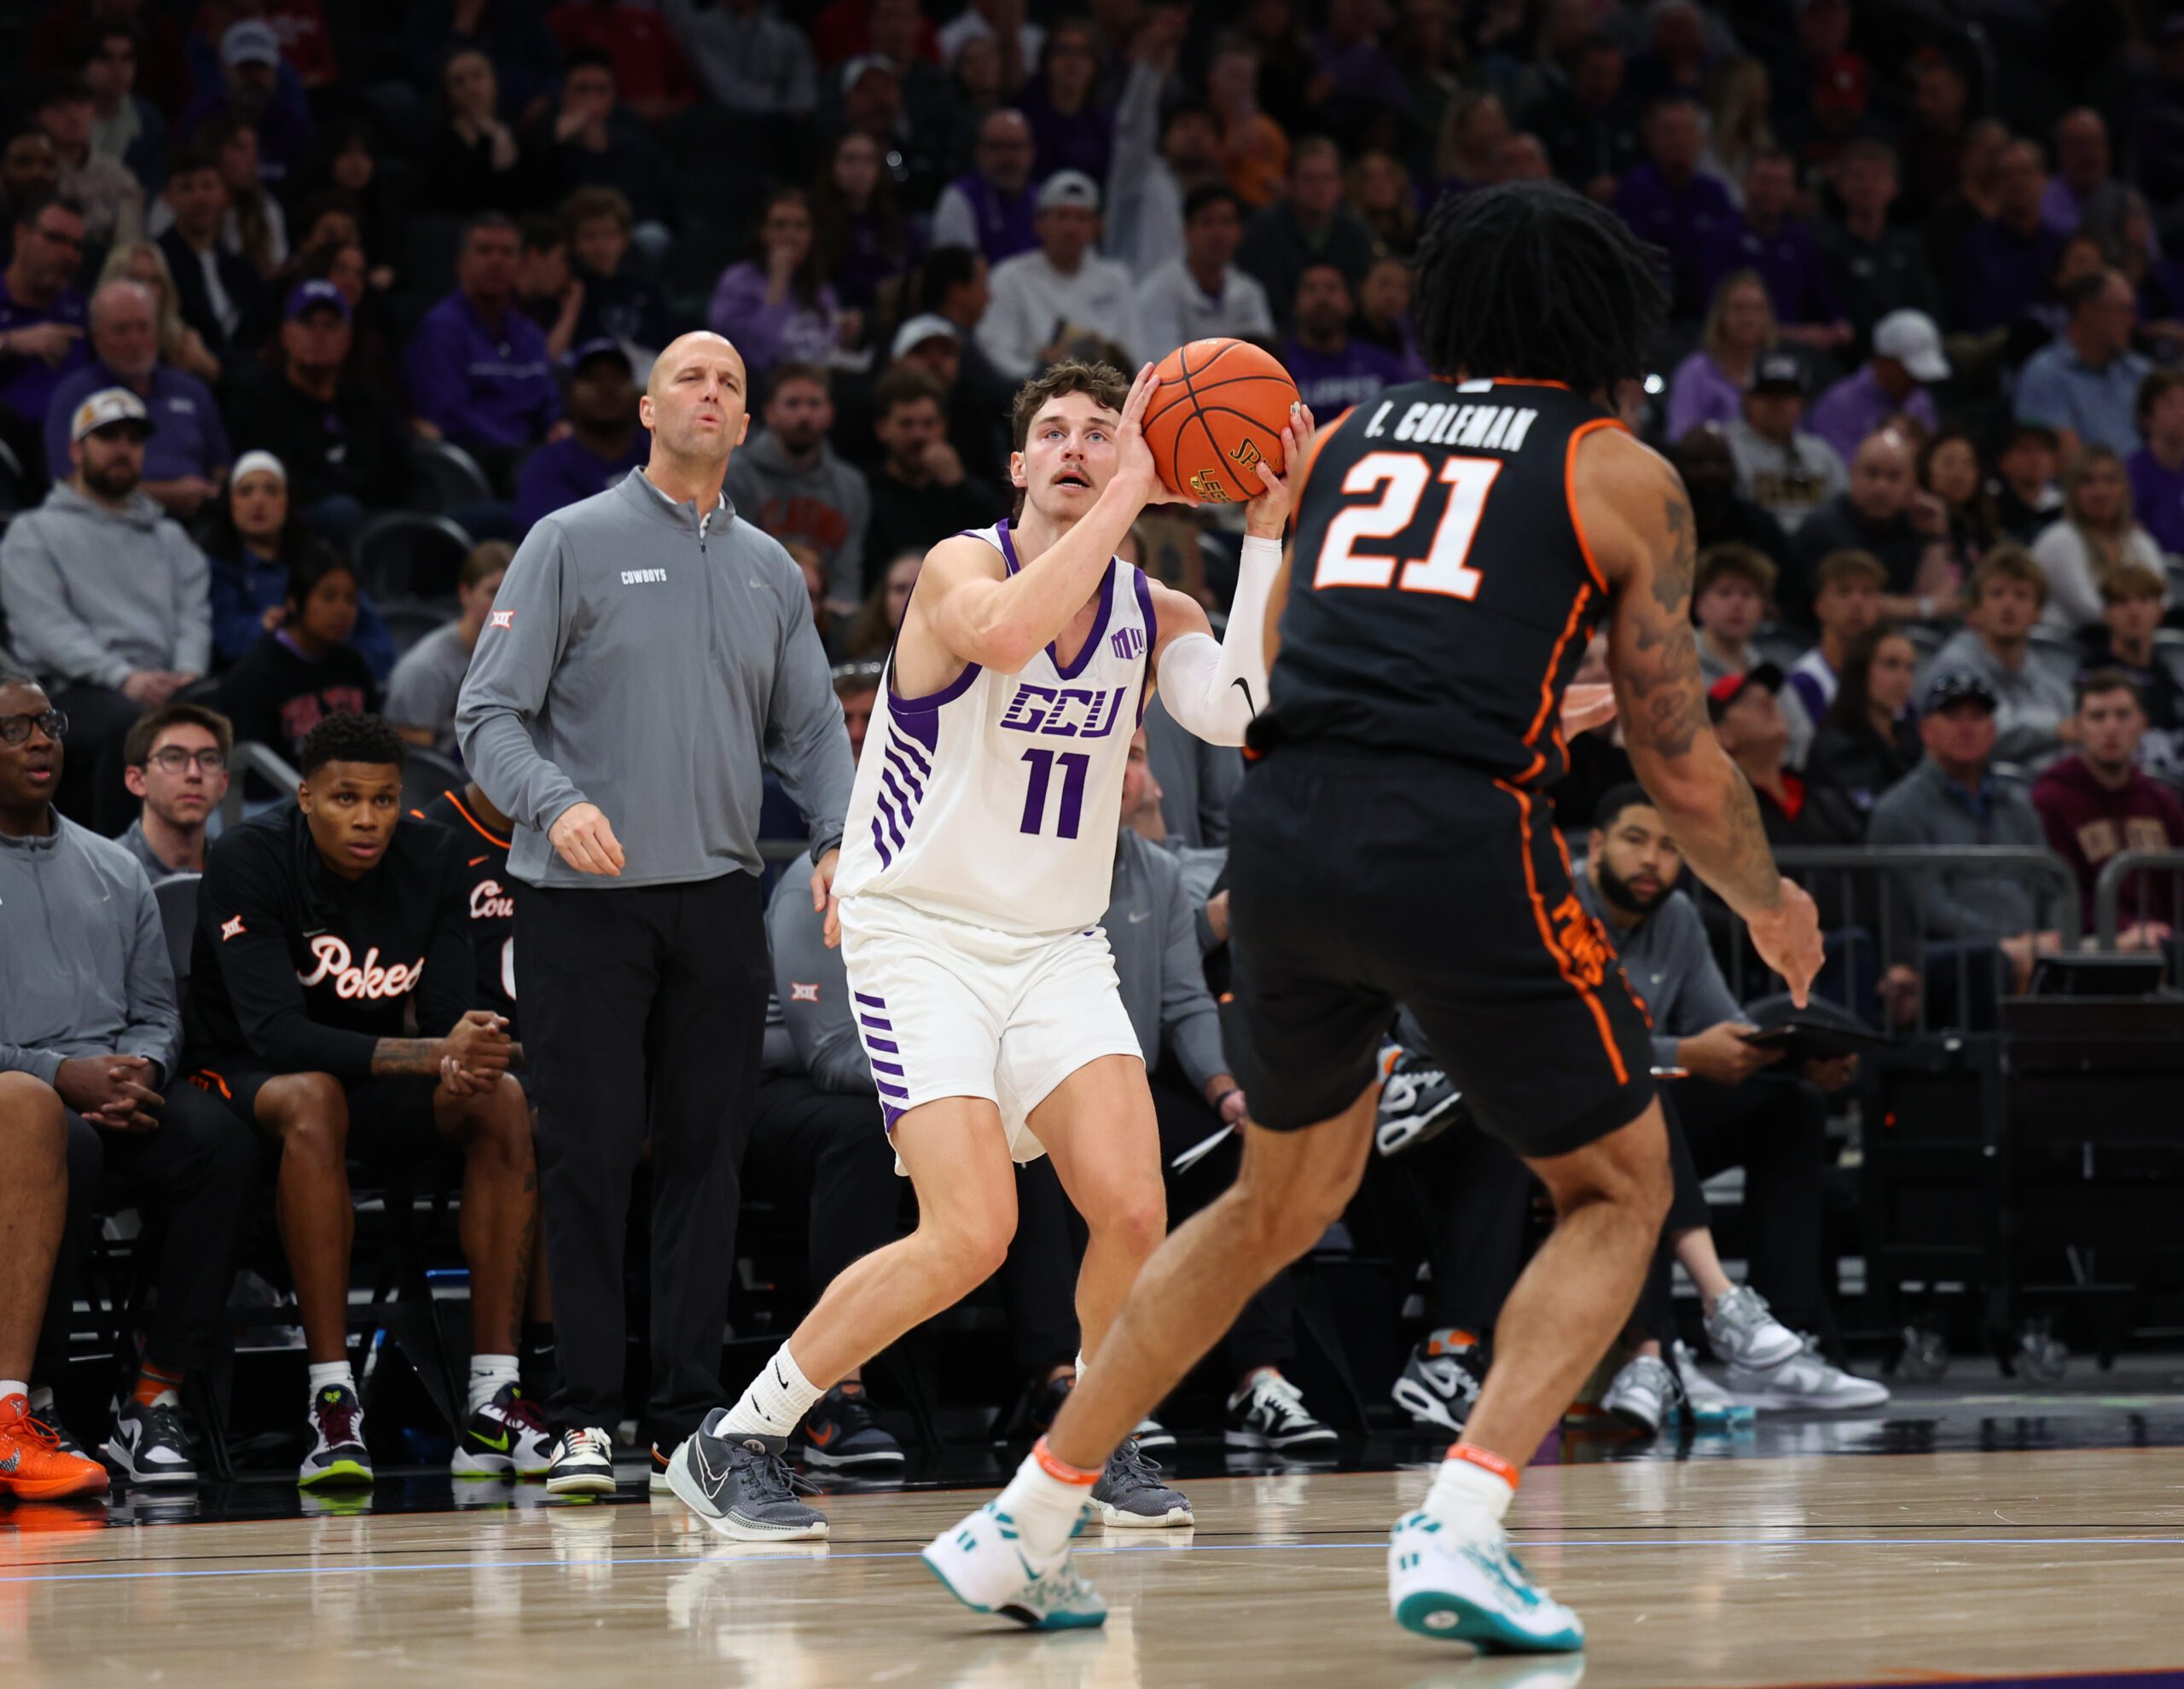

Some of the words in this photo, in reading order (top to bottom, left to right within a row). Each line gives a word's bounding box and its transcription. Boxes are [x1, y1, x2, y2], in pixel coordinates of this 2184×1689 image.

[1394, 402, 1538, 452] COLEMAN
[1312, 450, 1504, 602] 21
[621, 568, 667, 585] COWBOYS
[1000, 683, 1128, 738] GCU
[1019, 747, 1091, 839] 11
[296, 935, 425, 999] Pokes
